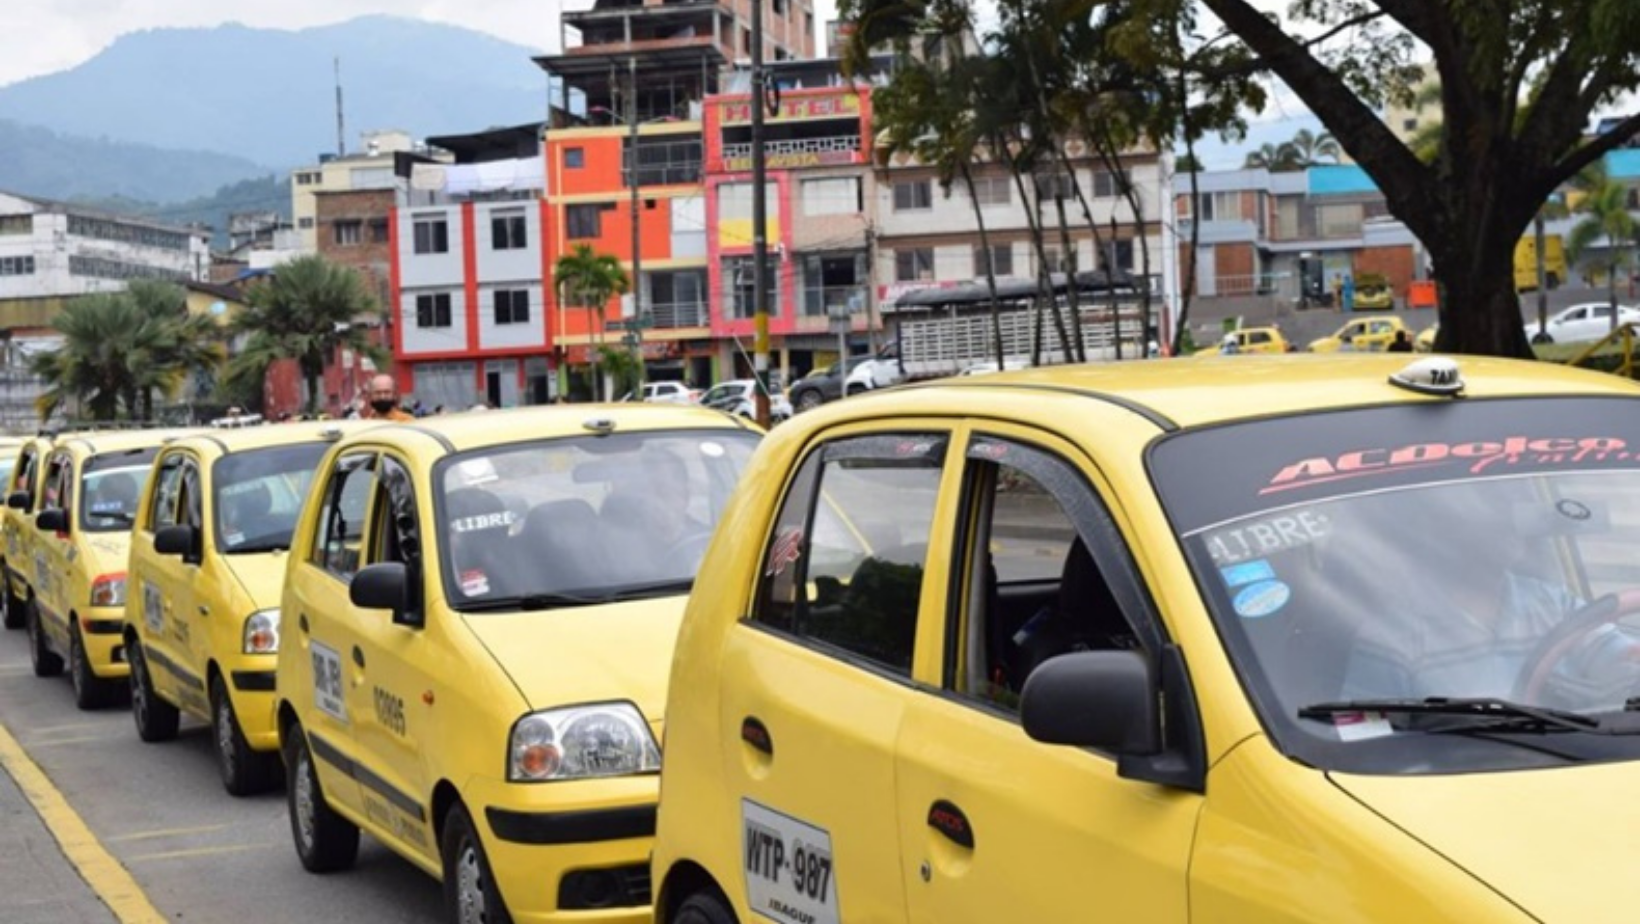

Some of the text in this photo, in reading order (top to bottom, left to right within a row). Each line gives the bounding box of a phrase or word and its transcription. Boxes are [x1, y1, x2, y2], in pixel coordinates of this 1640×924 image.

[726, 98, 856, 121] HTEL
[455, 511, 513, 533] LIBRE
[1213, 511, 1325, 561] LIBRE
